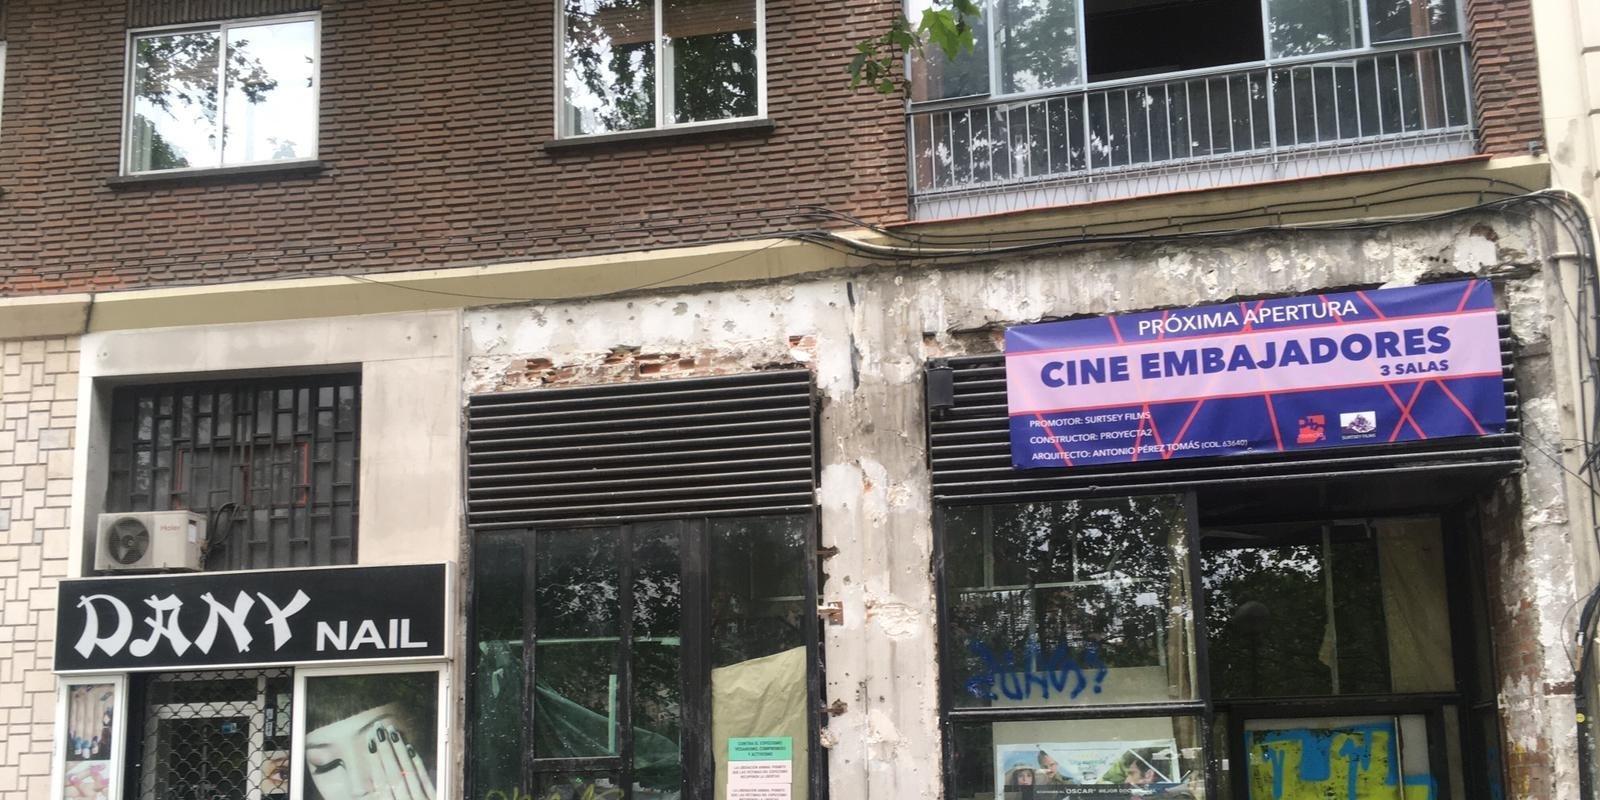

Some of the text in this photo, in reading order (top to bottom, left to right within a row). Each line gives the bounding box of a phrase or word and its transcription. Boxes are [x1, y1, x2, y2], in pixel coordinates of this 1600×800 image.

[1138, 299, 1359, 336] PRÓXIMA APERTURA
[1040, 325, 1452, 388] CINE EMBAJADORES
[1380, 359, 1450, 377] 3 SALAS
[1029, 410, 1151, 428] PROMOTOR: SURTSEY FILMS
[1029, 428, 1153, 444] CONSTRUCTOR: PROYECTA2
[1031, 449, 1092, 461] ARQUITECTO:
[1092, 446, 1136, 458] ANTONIO
[1137, 443, 1166, 455] PÉREZ
[1167, 440, 1200, 452] TOMÁS
[74, 589, 428, 660] DANY NAIL
